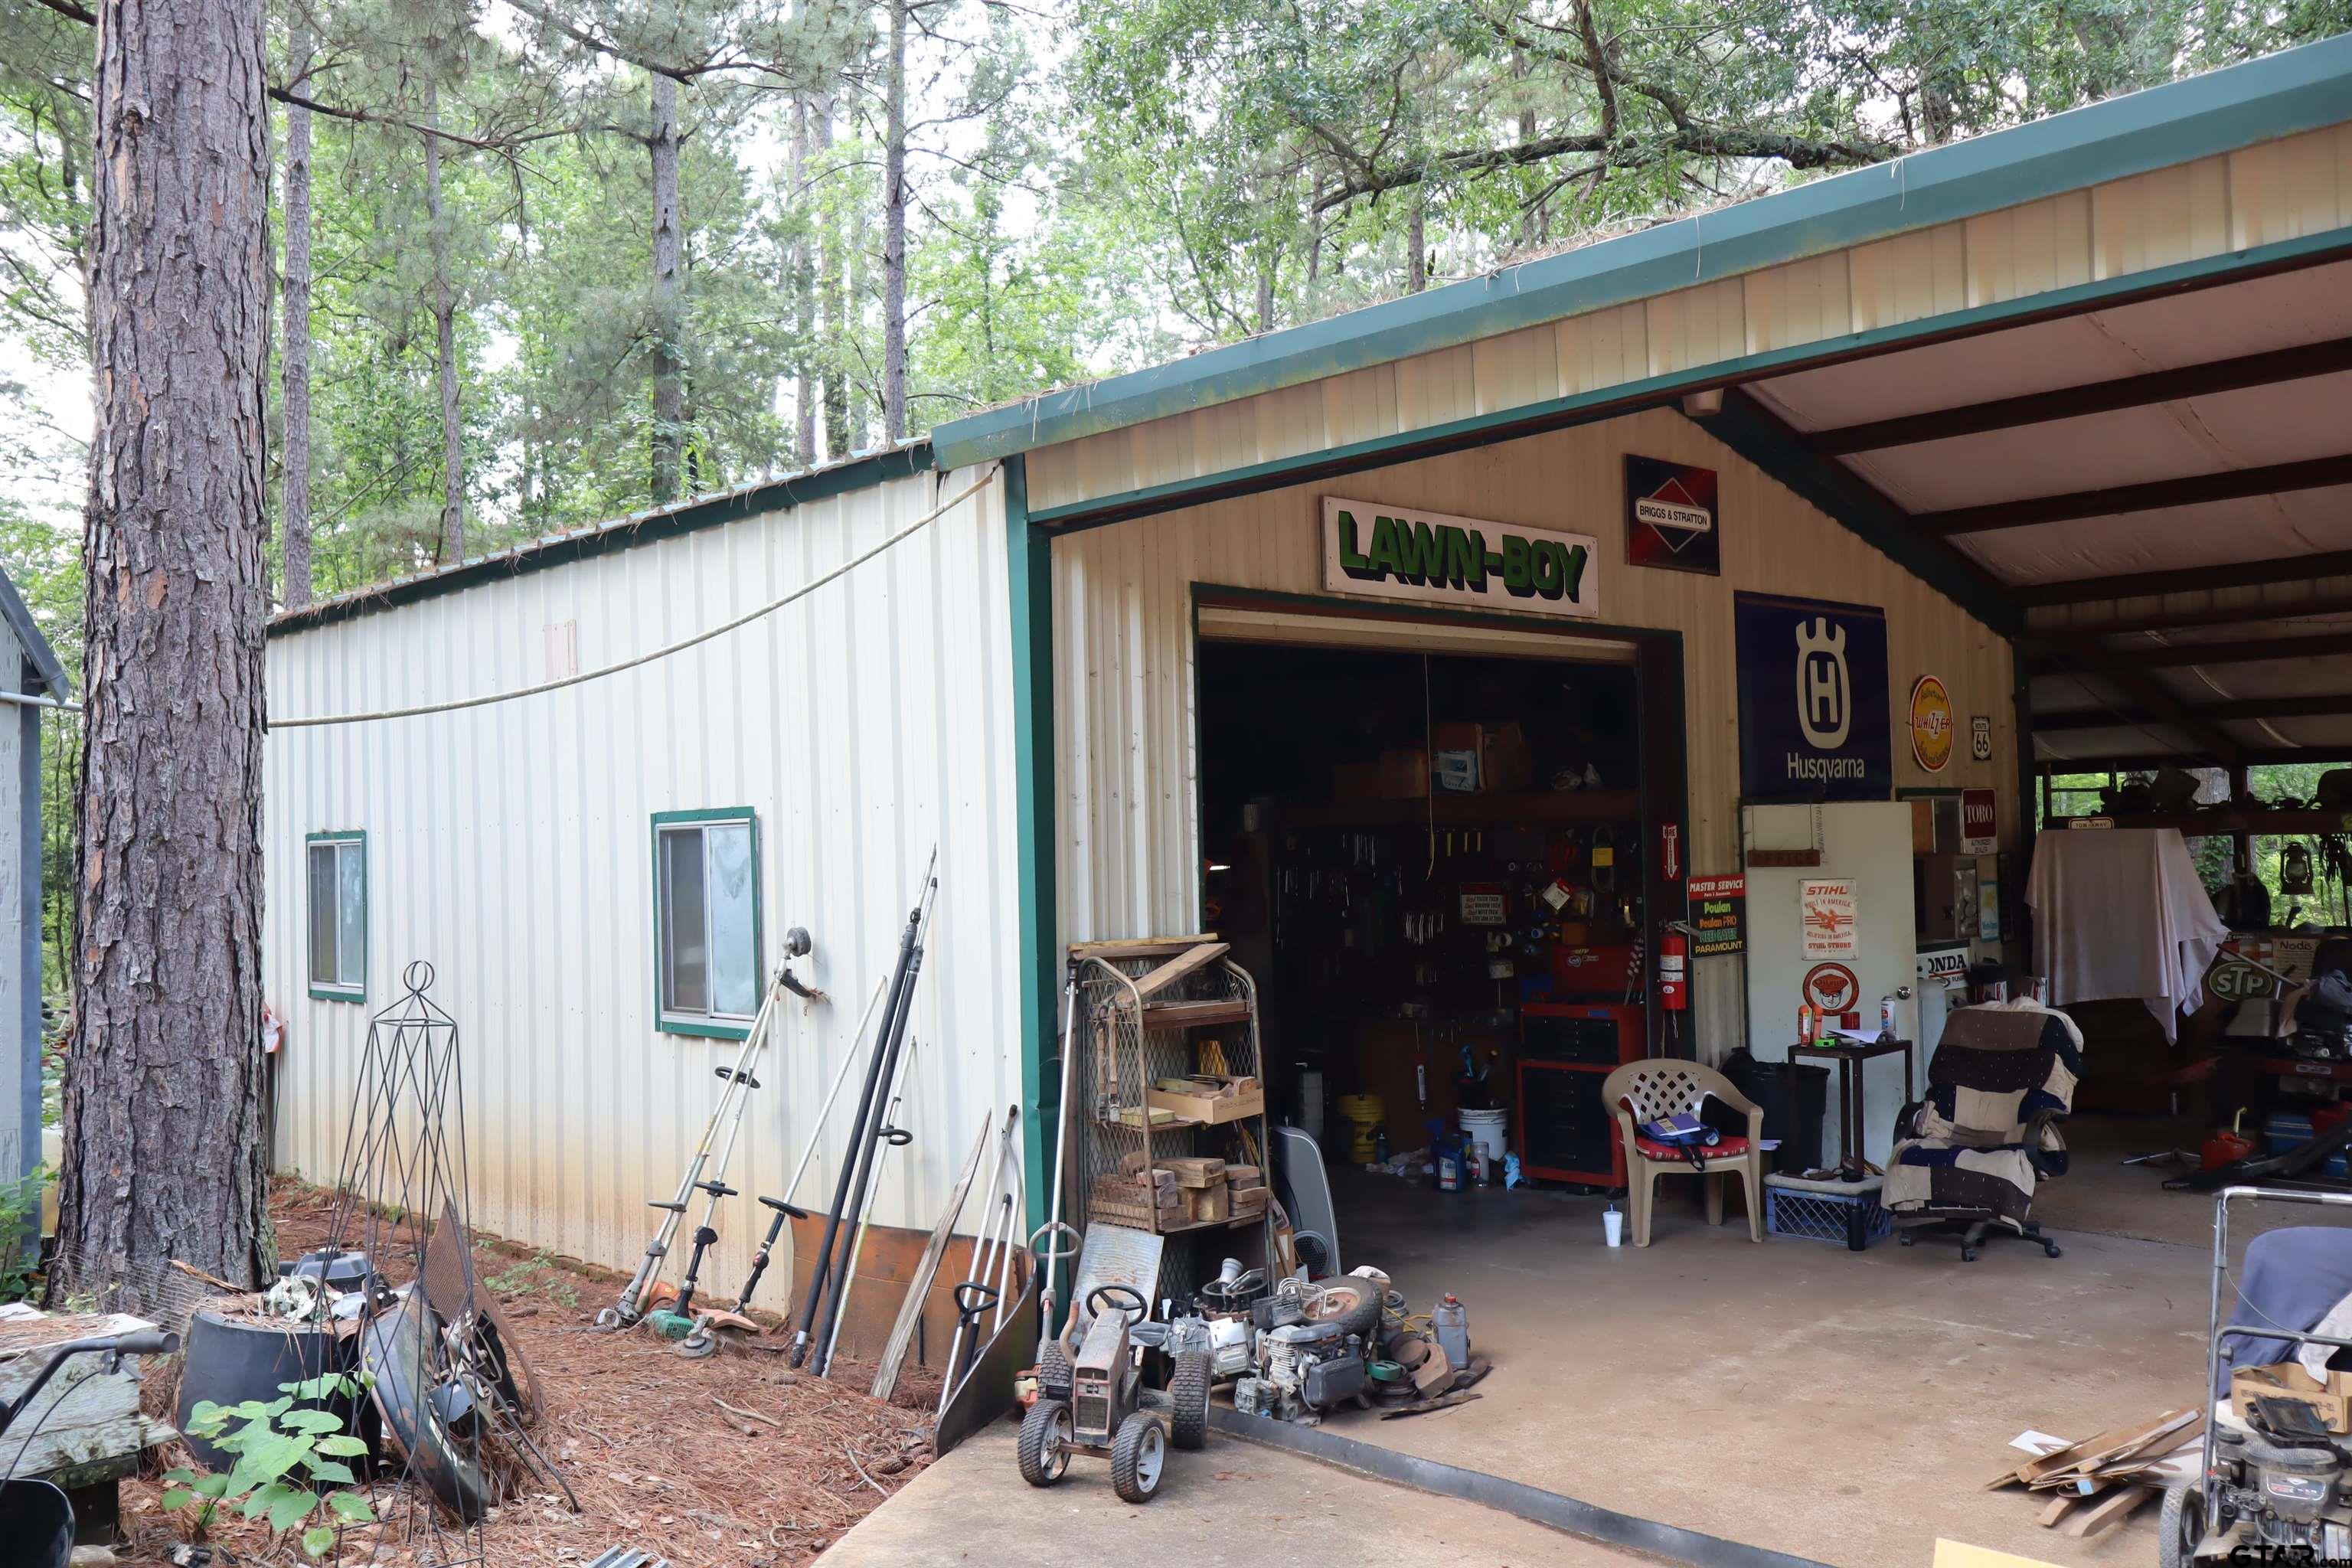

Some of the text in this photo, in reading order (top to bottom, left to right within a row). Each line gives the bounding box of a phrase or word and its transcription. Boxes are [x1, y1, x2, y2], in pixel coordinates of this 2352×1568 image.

[1639, 505, 1707, 526] BRIGGS & STRATTON
[1338, 510, 1588, 603] LAWN-BOY
[1915, 712, 1951, 735] WHIZZER
[1976, 733, 1989, 752] 66
[1787, 752, 1865, 783] Husqvarna
[1965, 804, 1994, 824] TORO
[1690, 880, 1744, 893] MASTER SERVICE
[1807, 886, 1848, 895] STIHL
[1704, 900, 1731, 914] Poulan
[1699, 915, 1737, 929] Poulan PRO
[1695, 940, 1743, 954] PARAMOUNT
[1928, 954, 1966, 974] ONDA
[2217, 966, 2264, 995] STP
